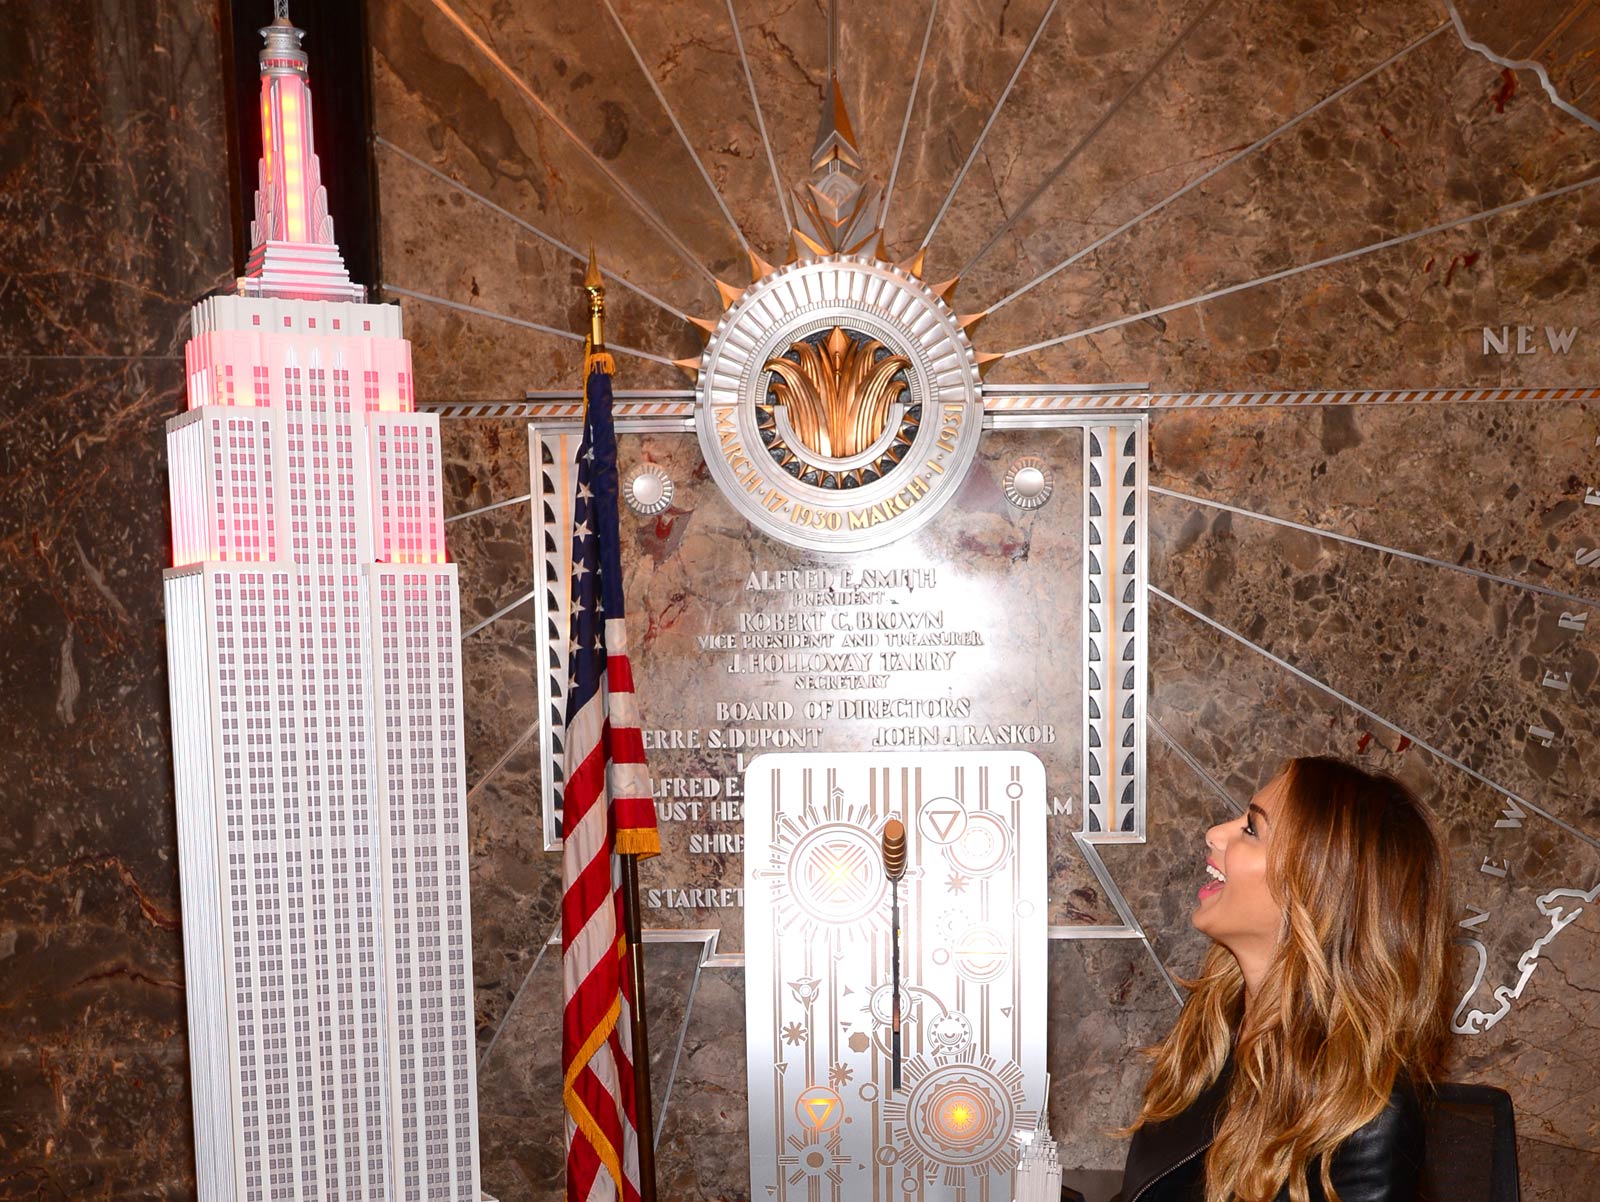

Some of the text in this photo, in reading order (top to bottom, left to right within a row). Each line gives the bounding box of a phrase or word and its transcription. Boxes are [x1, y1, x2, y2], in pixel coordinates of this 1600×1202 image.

[1483, 326, 1578, 355] NEW
[713, 406, 764, 494] MARCH
[847, 476, 930, 531] MARCH
[745, 570, 834, 590] ALFRED
[793, 591, 885, 606] PRESIDENT
[1528, 435, 1600, 749] JERSE
[740, 612, 826, 632] ROBERT
[697, 631, 984, 649] VICE PRESIDENT AND TREASURER
[880, 651, 956, 671] TARRY
[794, 674, 890, 690] SECRETARY
[716, 698, 971, 721] BOARD OF DIRECTORS
[643, 729, 700, 749] ERRE
[872, 725, 939, 746] JOHN
[649, 777, 720, 797] LFRED
[654, 801, 702, 821] UST
[689, 834, 744, 853] SHRE
[647, 888, 744, 908] STARRET
